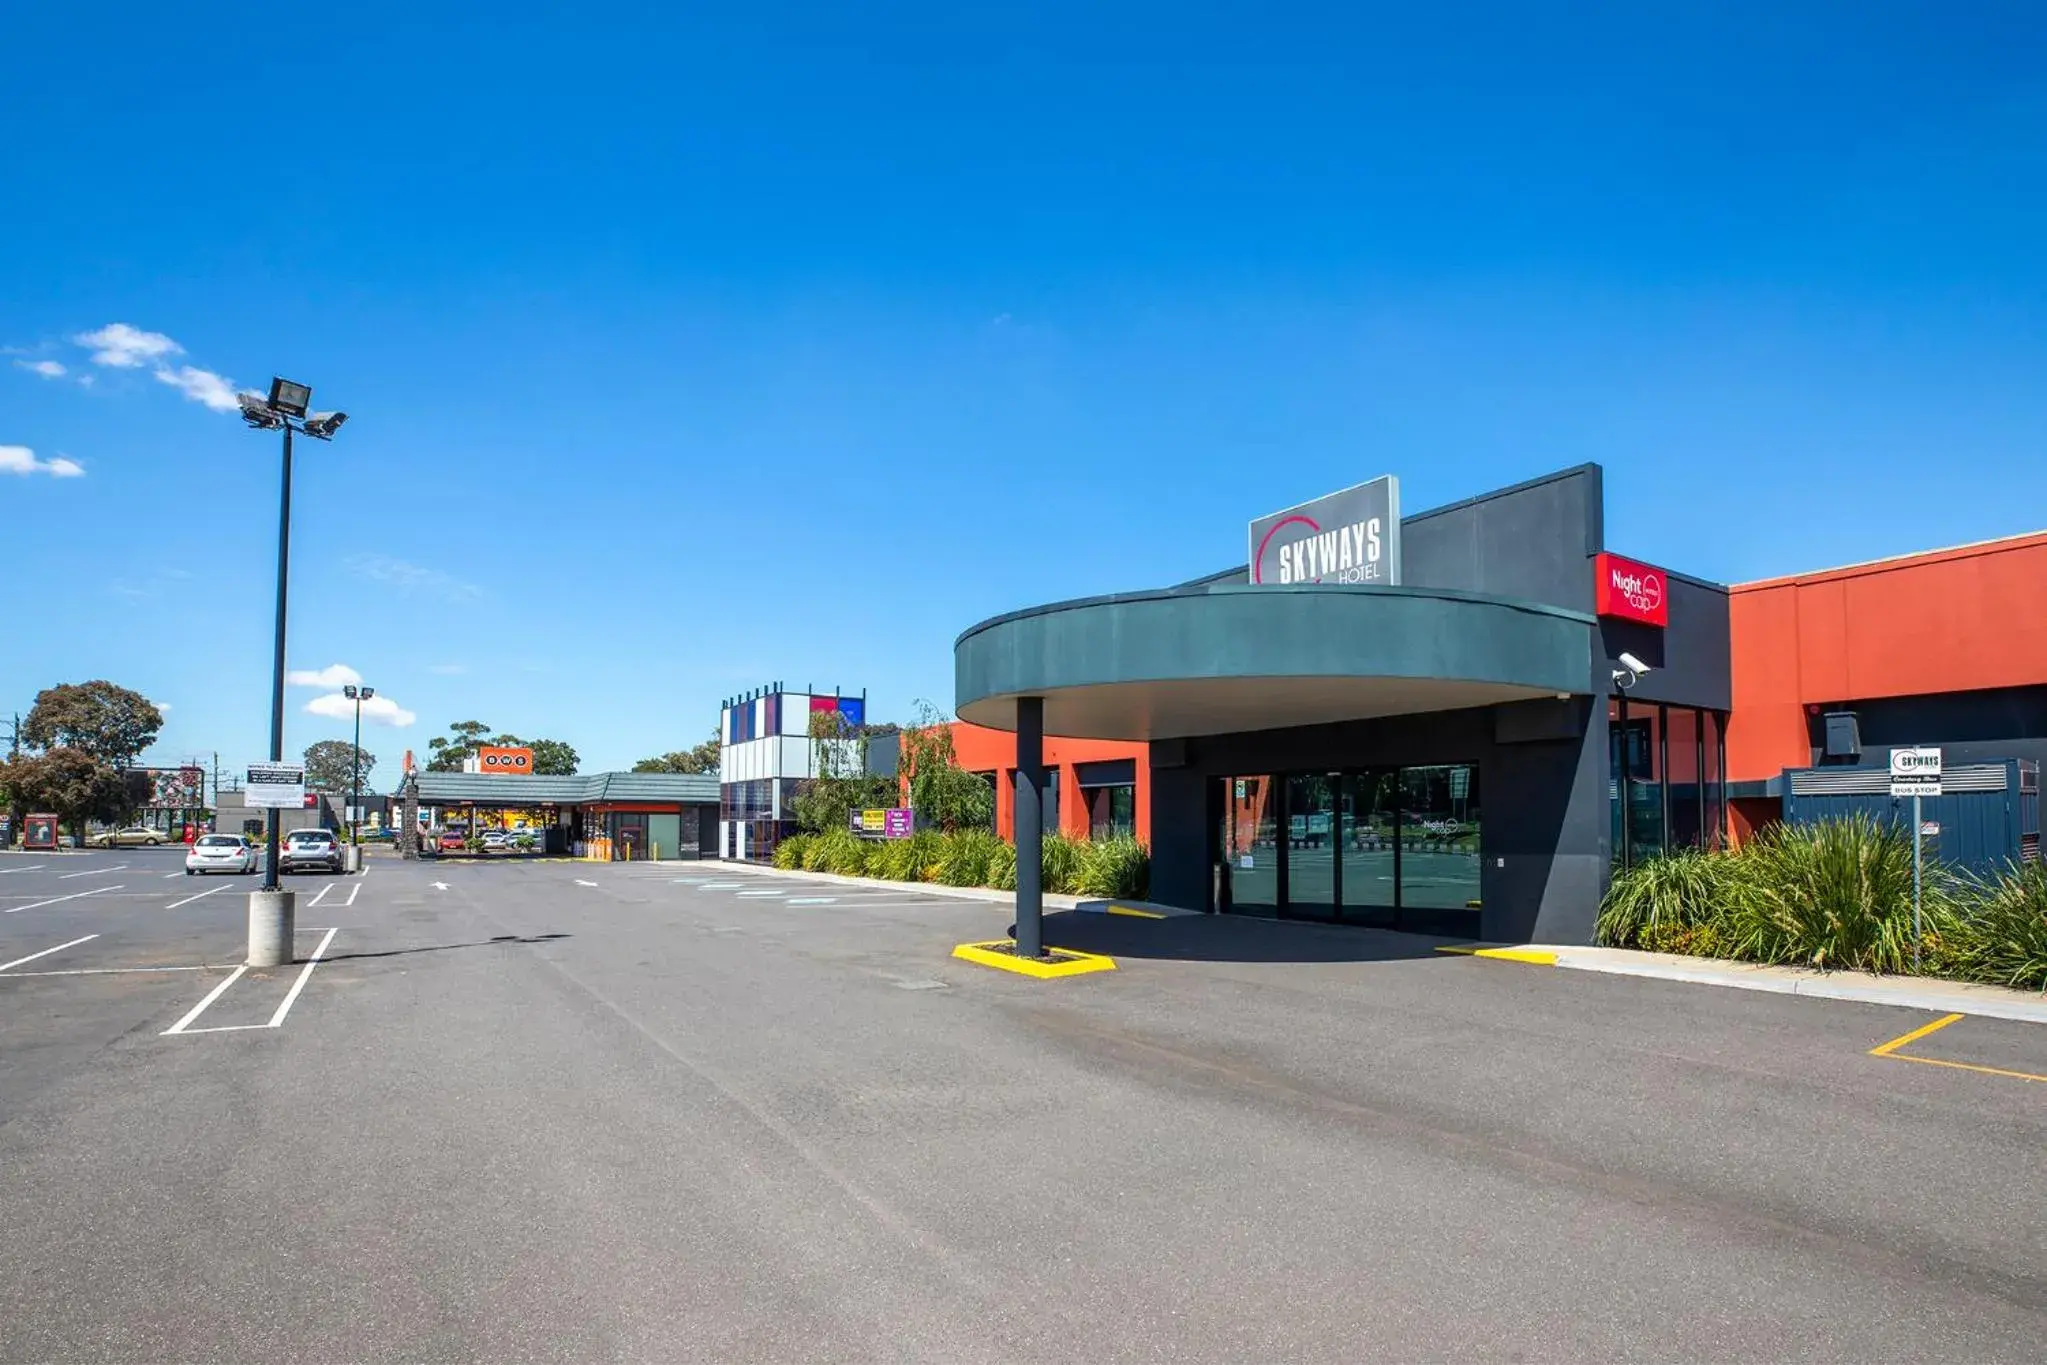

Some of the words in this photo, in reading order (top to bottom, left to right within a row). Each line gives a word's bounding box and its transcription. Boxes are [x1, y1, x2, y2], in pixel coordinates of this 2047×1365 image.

[1280, 517, 1380, 584] SKYWAYS
[1339, 563, 1380, 584] HOTEL
[1612, 569, 1642, 598] Night
[1630, 594, 1651, 614] cap
[1902, 756, 1939, 767] SKYWAYS
